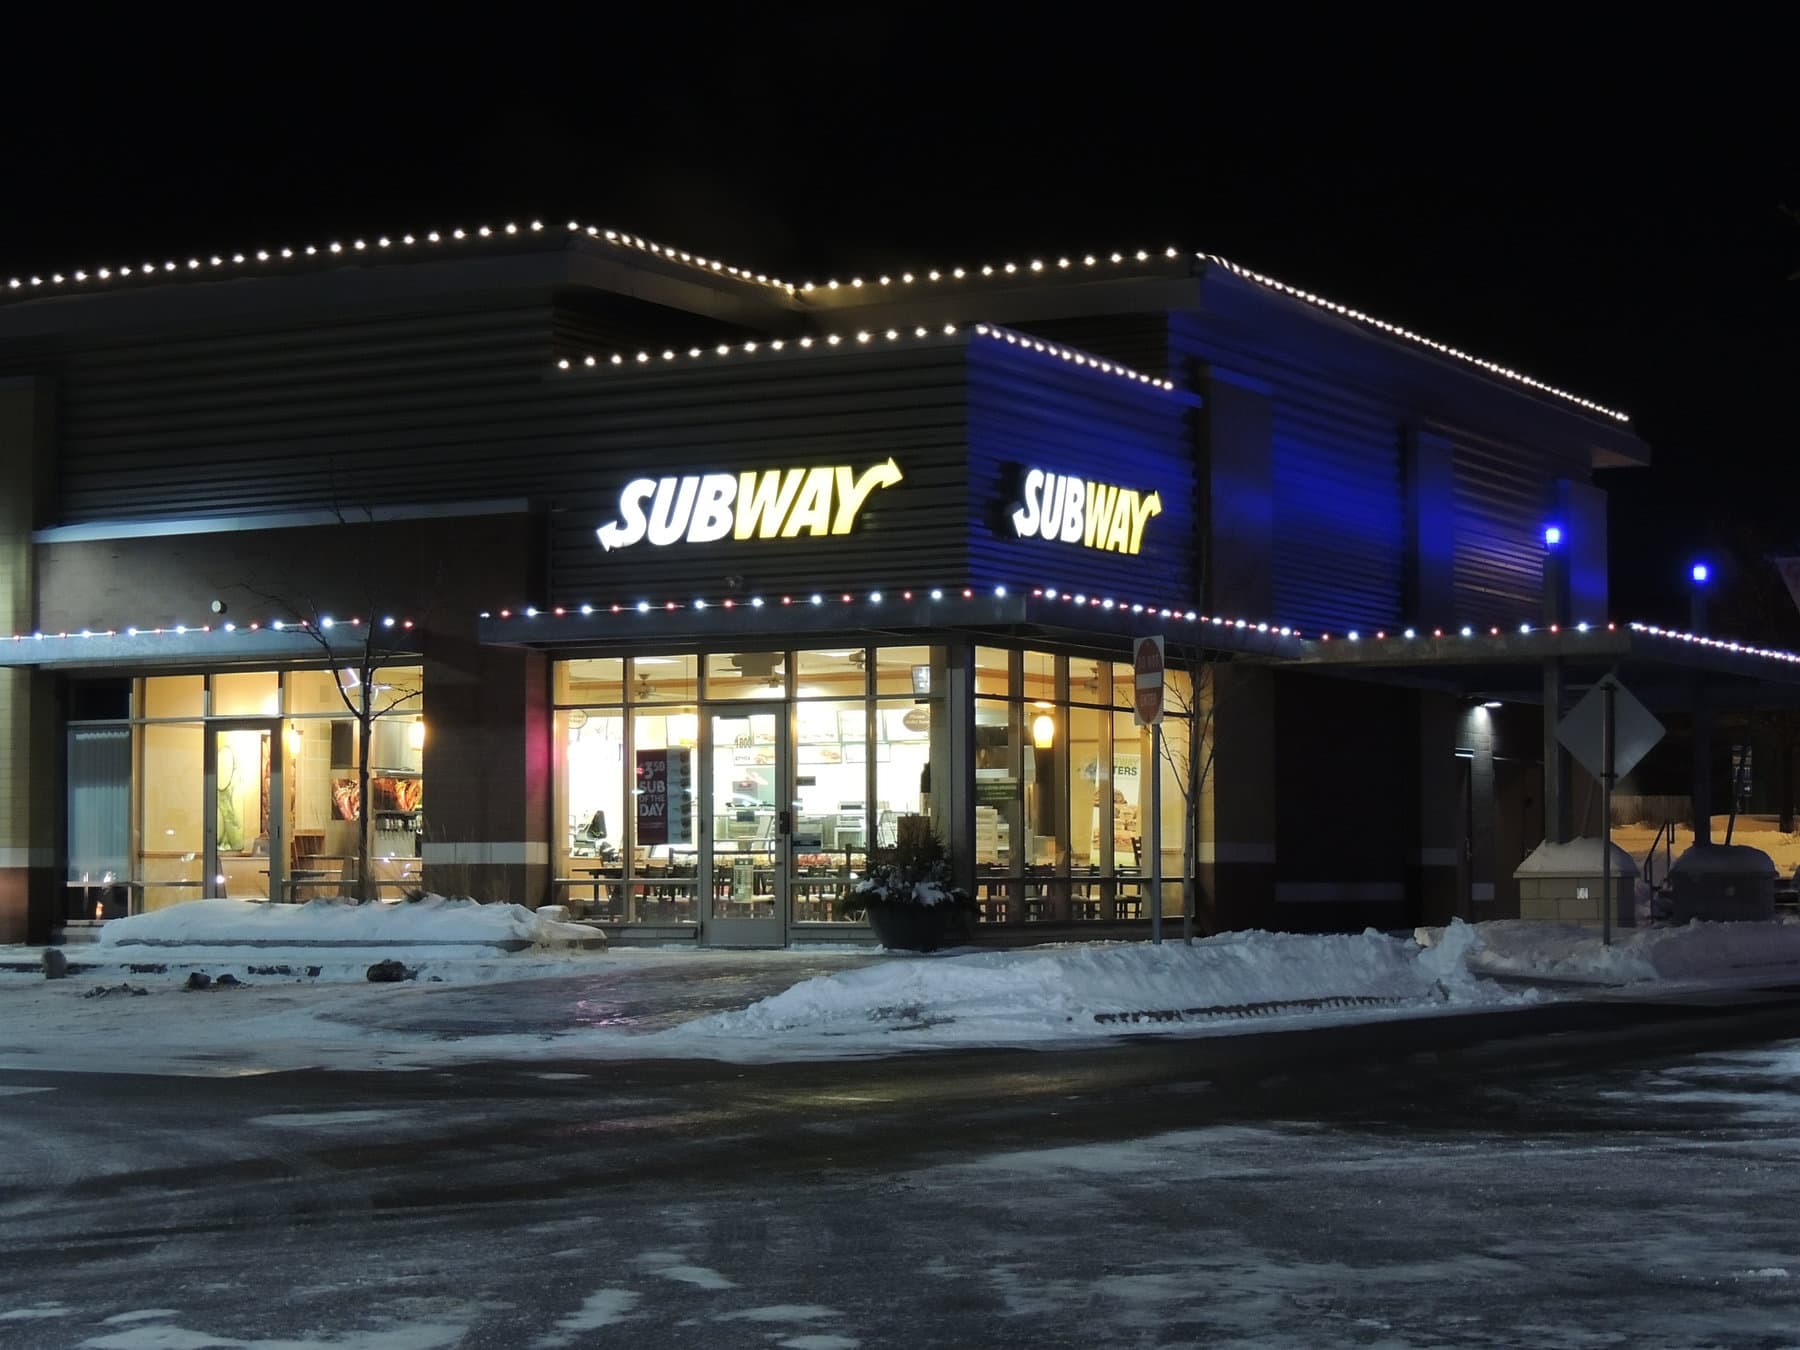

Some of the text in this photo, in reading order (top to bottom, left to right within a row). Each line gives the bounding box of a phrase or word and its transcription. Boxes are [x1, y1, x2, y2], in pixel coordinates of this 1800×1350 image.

[596, 457, 903, 552] SUBWAY
[1012, 468, 1162, 555] SUBWAY
[639, 780, 666, 794] SUB
[650, 793, 666, 802] THE
[640, 803, 665, 817] DAY
